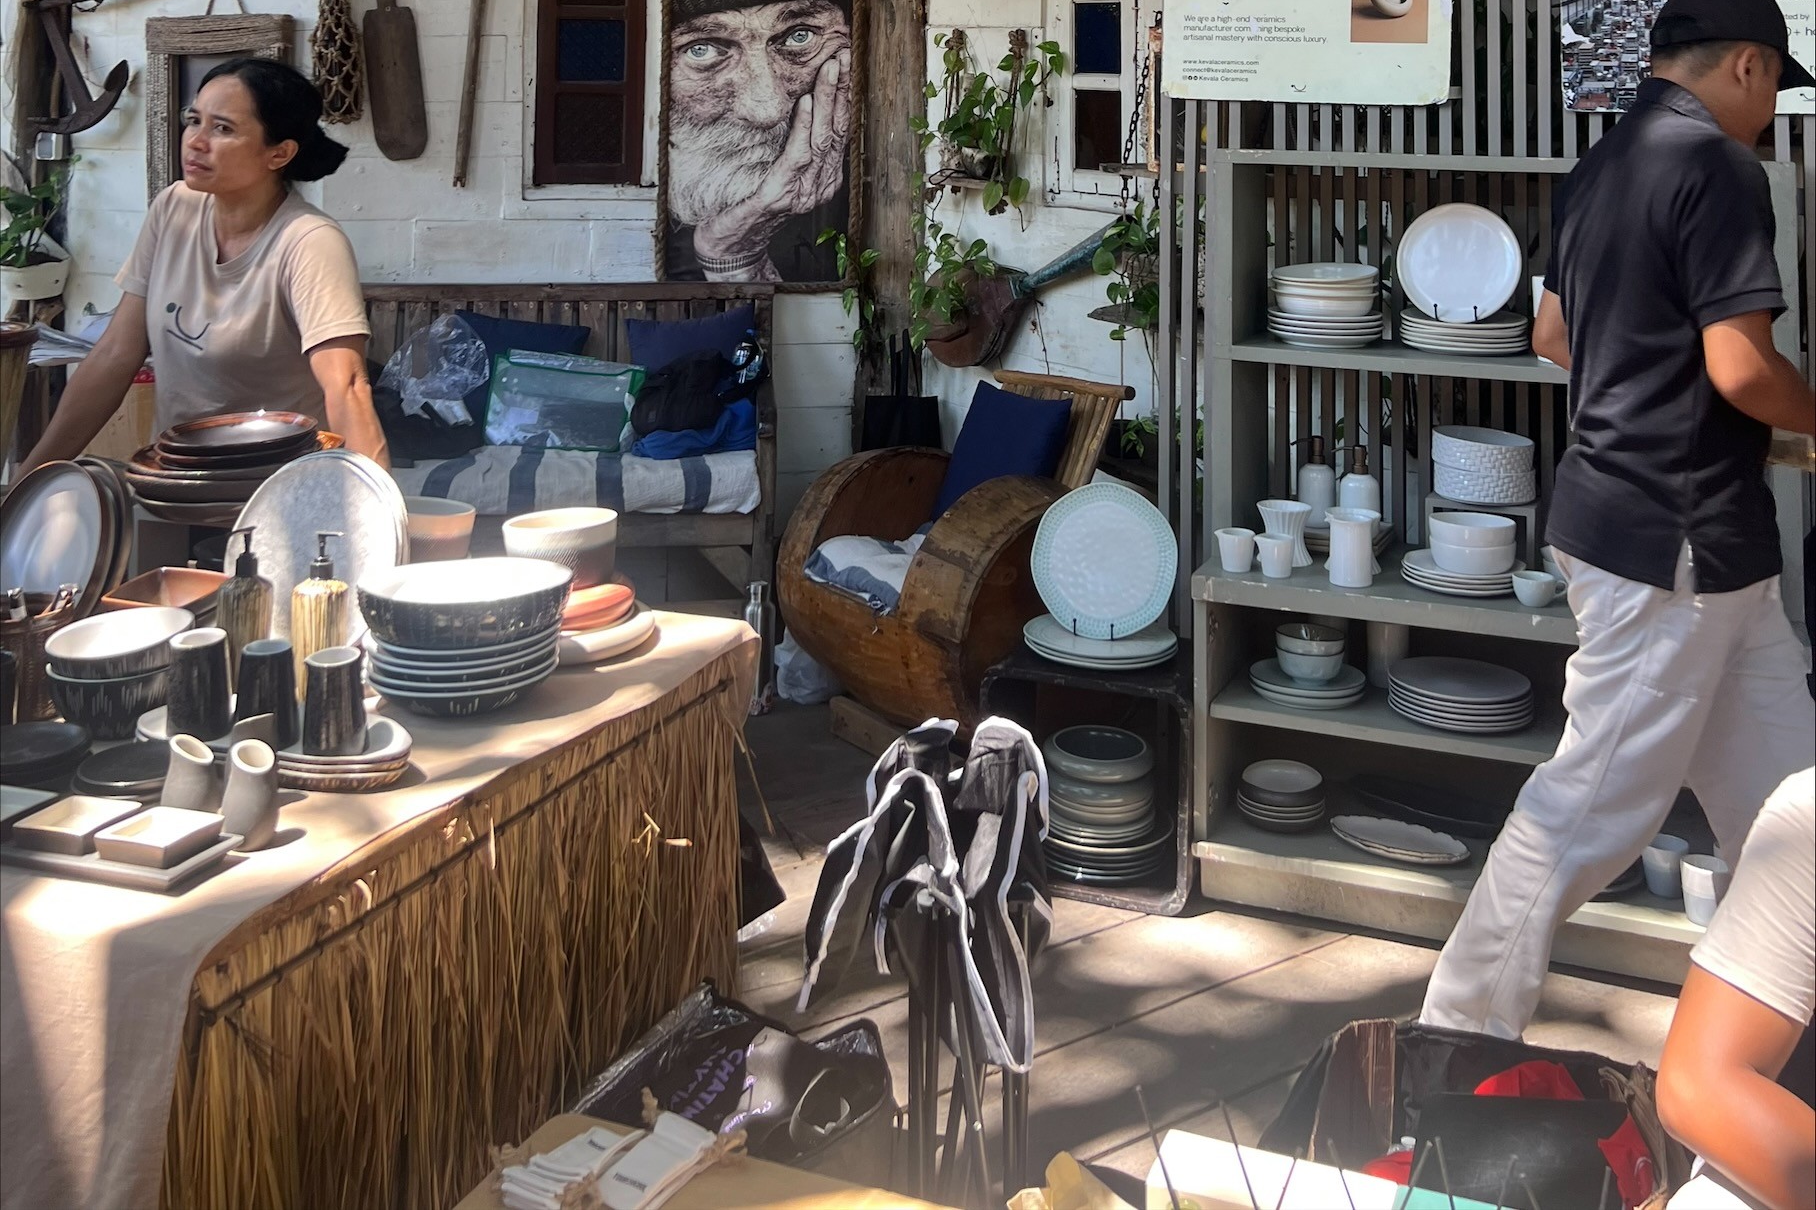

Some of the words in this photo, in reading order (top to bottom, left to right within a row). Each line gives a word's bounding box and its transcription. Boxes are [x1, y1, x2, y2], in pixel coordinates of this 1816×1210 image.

[1217, 15, 1251, 24] high-end
[1799, 13, 1810, 21] by
[1183, 24, 1233, 32] manufacturer
[1274, 25, 1306, 34] bespoke
[1183, 33, 1214, 41] artisanal
[1215, 34, 1245, 43] mastery
[1247, 34, 1263, 42] with
[1264, 35, 1302, 43] conscious
